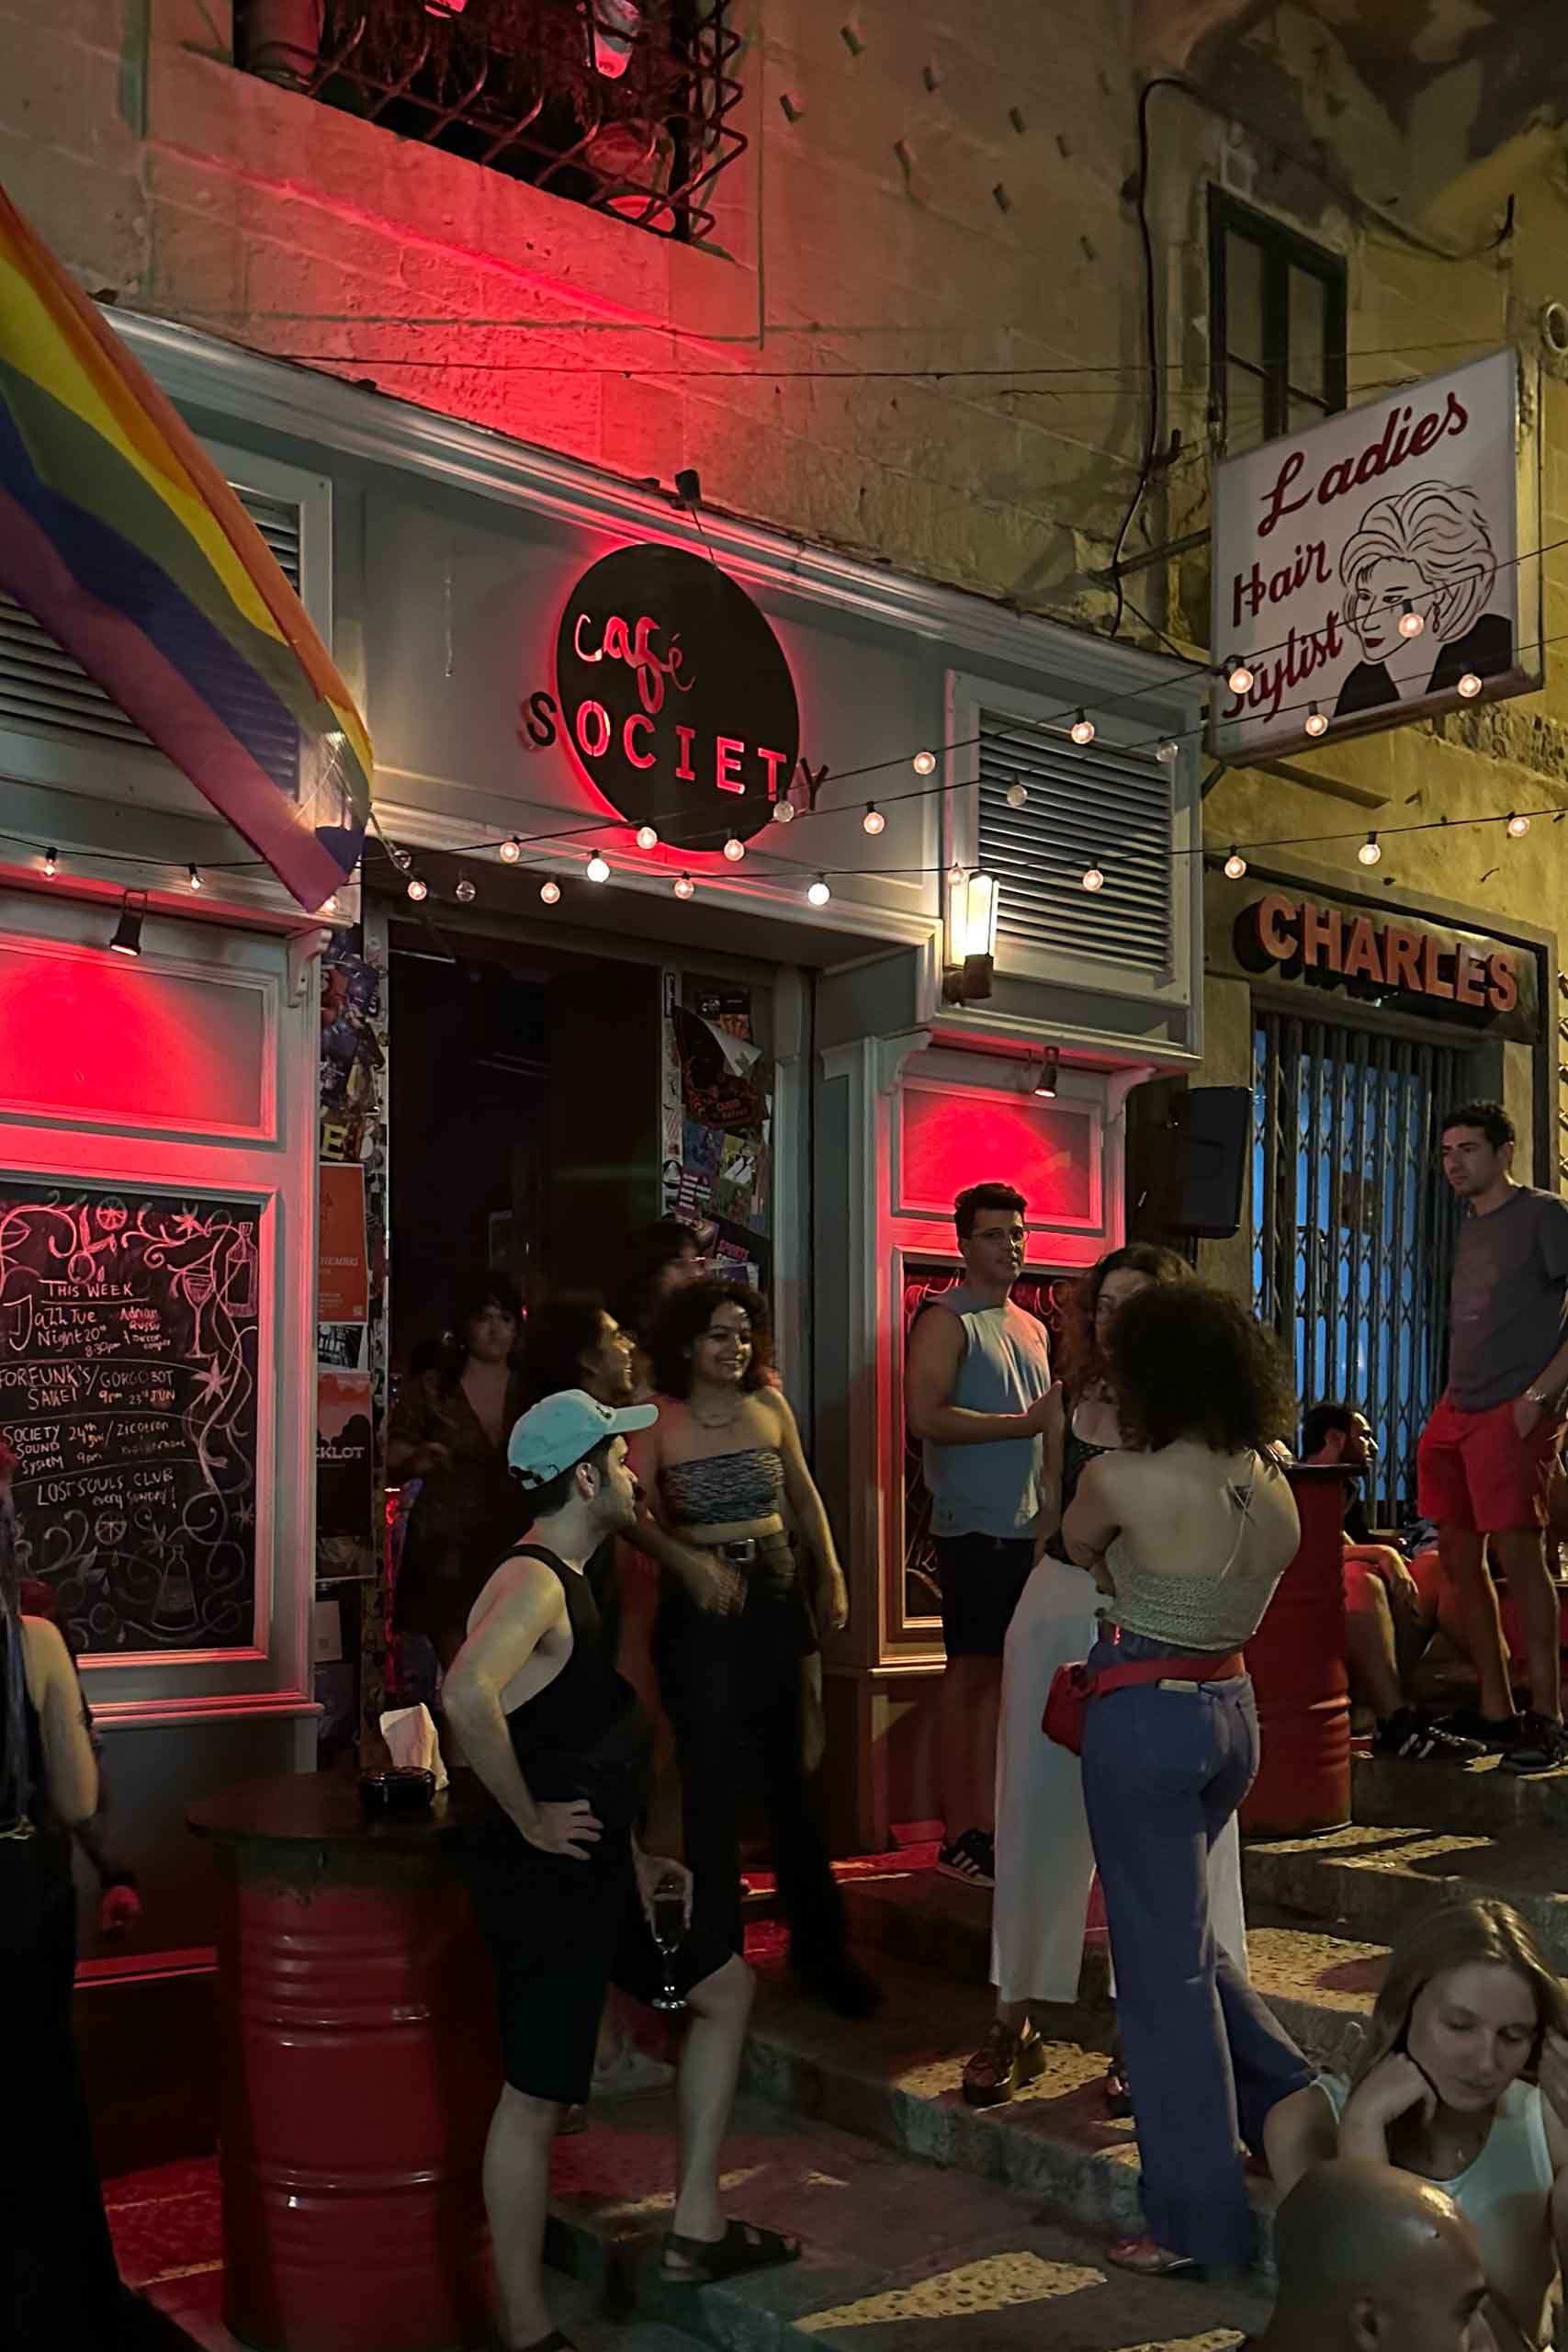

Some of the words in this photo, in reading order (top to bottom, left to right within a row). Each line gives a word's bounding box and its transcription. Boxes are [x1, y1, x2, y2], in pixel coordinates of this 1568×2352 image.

[1257, 391, 1468, 537] Ladies
[1233, 541, 1332, 627] Hair
[526, 691, 829, 811] SOCIETY
[1256, 895, 1517, 1012] CHARLES
[38, 1279, 80, 1297] THIS
[86, 1282, 134, 1298] WEEK
[37, 1329, 84, 1353] Night
[2, 1424, 61, 1446] SOCIETY
[15, 1442, 61, 1460] SOUND
[317, 1446, 366, 1460] KLOT
[37, 1479, 74, 1506] LOST
[76, 1476, 126, 1498] SOULS
[132, 1467, 175, 1487] CLUB
